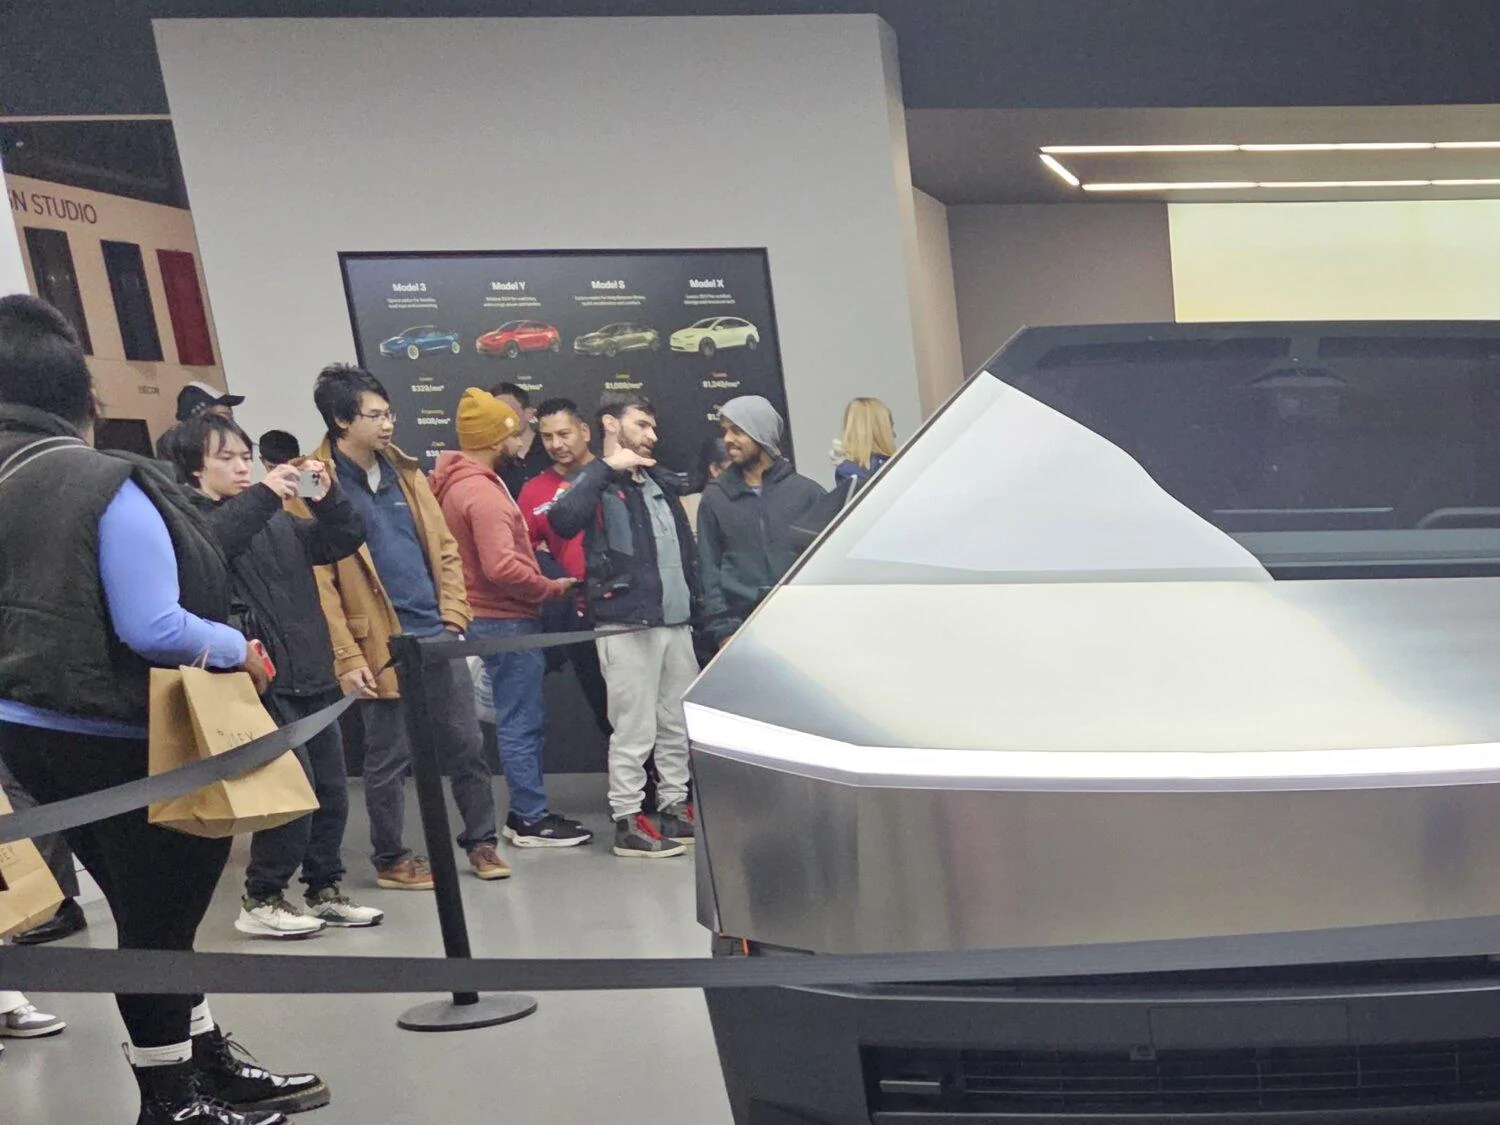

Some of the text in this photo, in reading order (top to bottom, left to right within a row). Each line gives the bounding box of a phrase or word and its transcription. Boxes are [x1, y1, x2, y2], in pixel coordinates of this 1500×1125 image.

[31, 193, 98, 225] STUDIO
[392, 283, 419, 292] Model
[491, 281, 526, 290] Model Y
[591, 280, 626, 289] Model S
[689, 279, 724, 288] Model X
